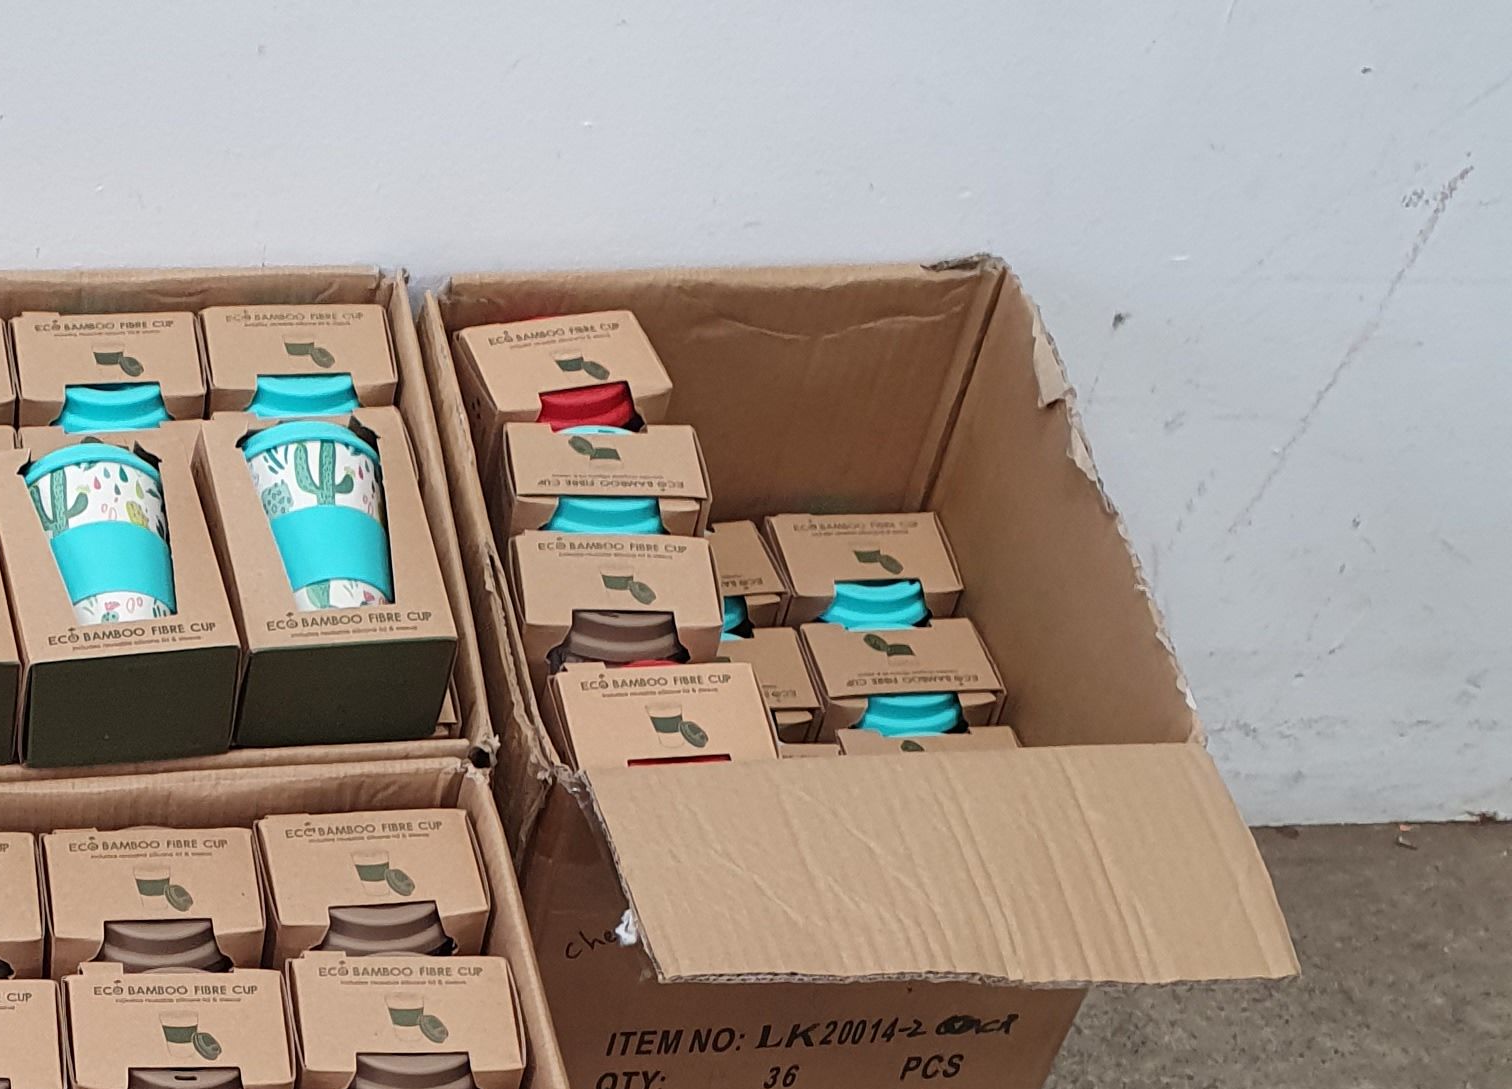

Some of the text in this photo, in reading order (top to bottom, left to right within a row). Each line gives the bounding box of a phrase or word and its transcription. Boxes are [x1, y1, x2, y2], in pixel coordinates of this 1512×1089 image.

[62, 321, 116, 332] BAMBOO
[118, 320, 148, 330] FIBRE
[150, 319, 175, 329] CUP
[265, 615, 299, 632] ECO
[300, 613, 364, 628] BAMBOO
[367, 611, 402, 624] FIBRE
[405, 610, 433, 622] CUP
[46, 630, 81, 647] ECO
[81, 626, 146, 642] BAMBOO
[149, 622, 186, 636] FIBRE
[188, 621, 217, 633] CUP
[579, 677, 610, 692] ECO
[611, 676, 669, 689] BAMBOO
[671, 674, 704, 687] FIBRE
[706, 672, 732, 685] CUP
[5, 991, 33, 1003] CUP
[92, 983, 259, 997] ECO BAMBOO FIBRE CUP
[605, 1029, 684, 1056] ITEM
[688, 1027, 745, 1053] NO:
[763, 1064, 800, 1089] 36
[900, 1054, 964, 1080] PCS
